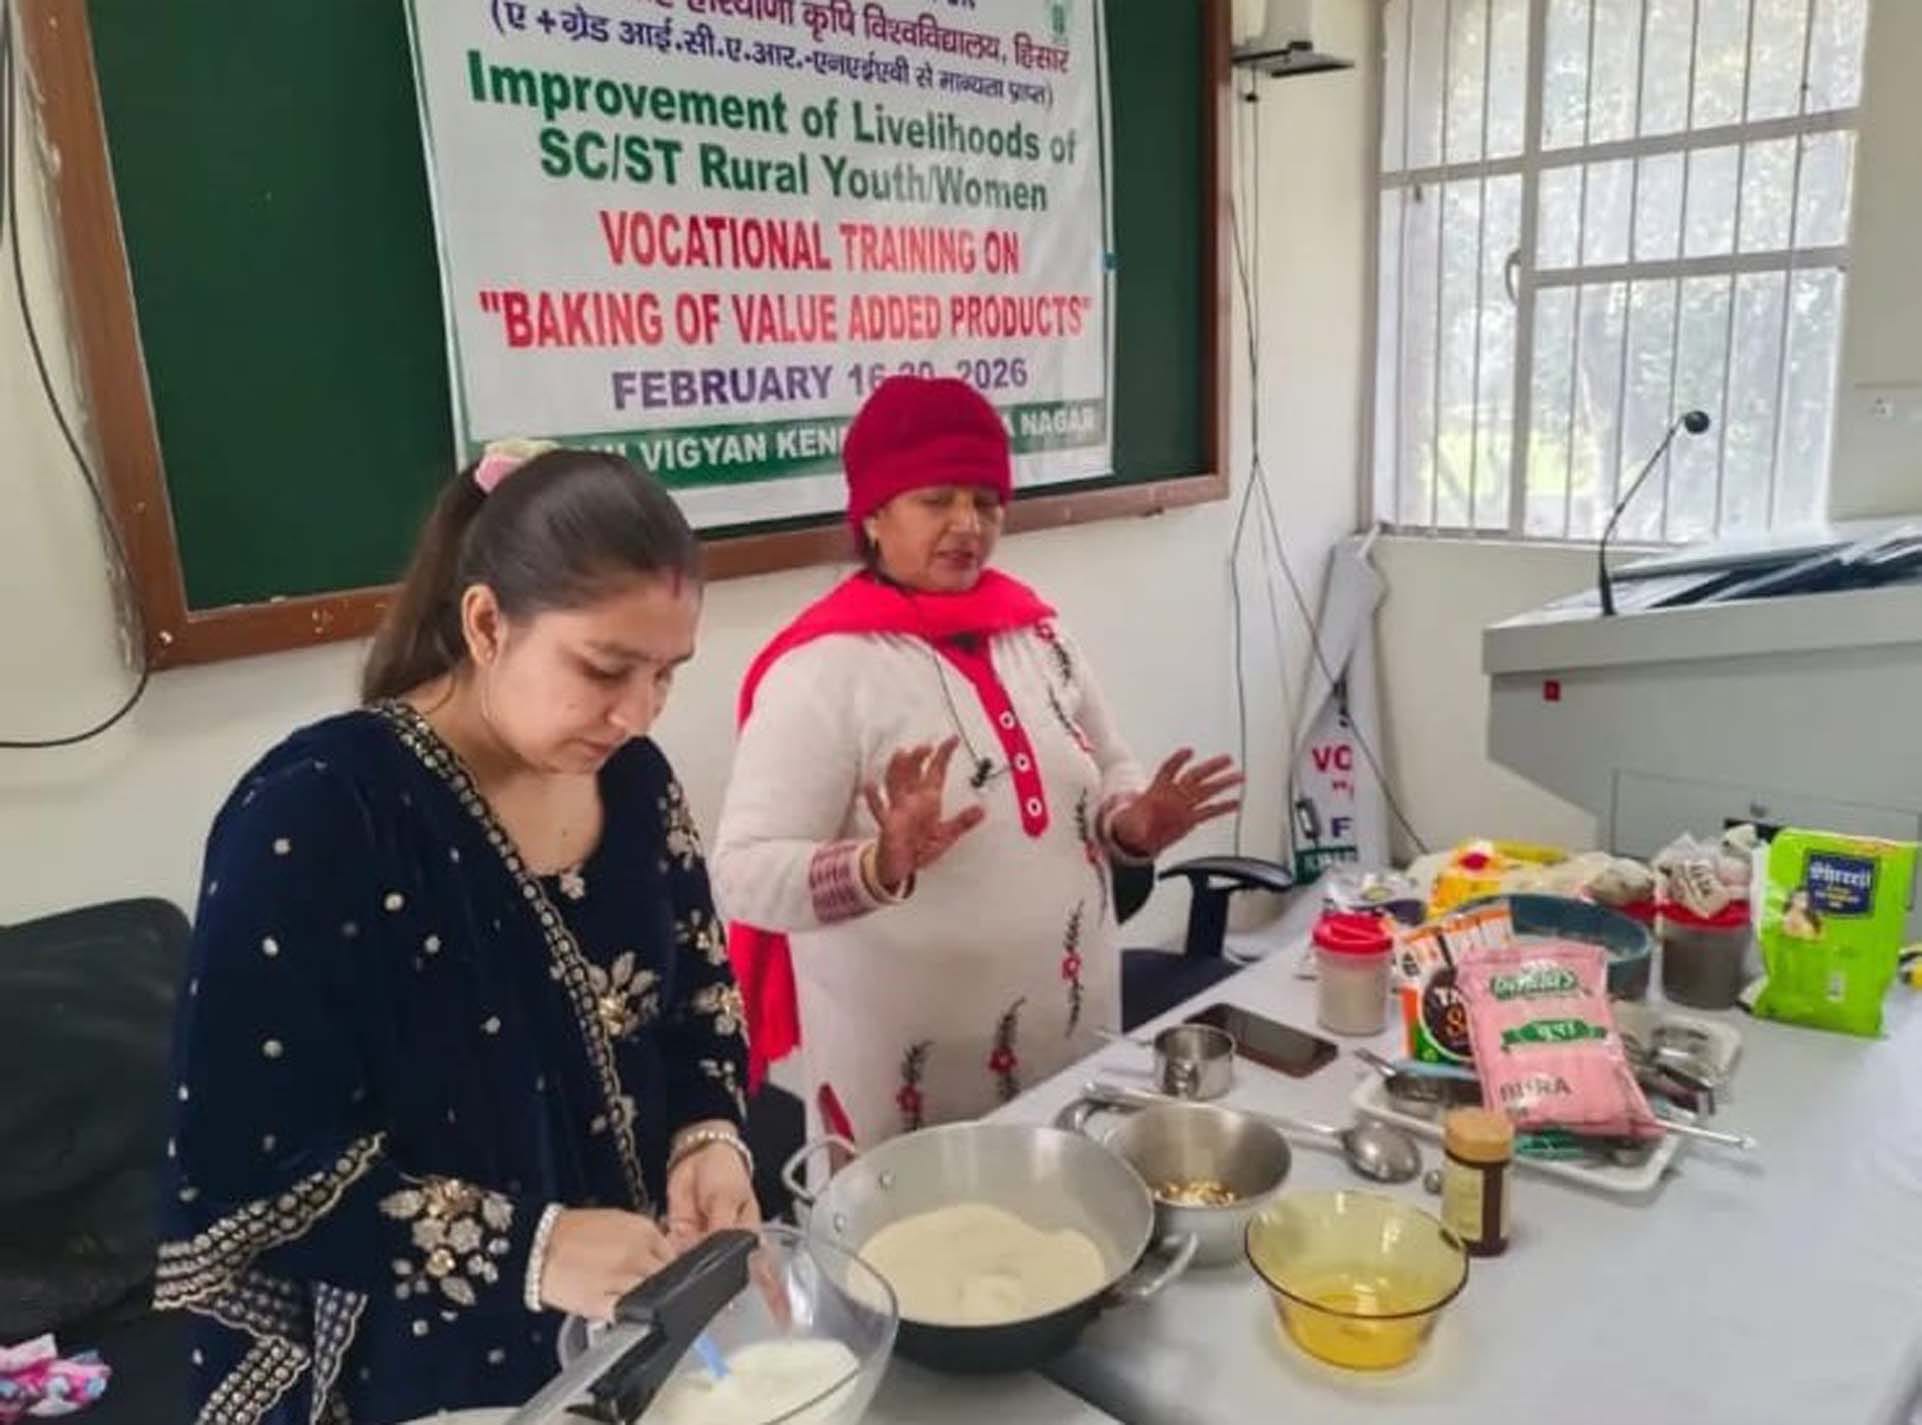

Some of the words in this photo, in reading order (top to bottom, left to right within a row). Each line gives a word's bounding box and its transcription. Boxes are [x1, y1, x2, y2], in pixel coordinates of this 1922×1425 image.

[915, 61, 933, 89] से
[938, 68, 1004, 98] मान्यता
[1014, 32, 1069, 73] हिसार
[467, 50, 788, 137] Improvement
[803, 97, 839, 140] of
[853, 101, 1040, 161] Livelihoods
[1050, 129, 1077, 165] of
[539, 127, 683, 186] SC/ST
[698, 142, 809, 197] Rural
[820, 154, 1048, 211] Youth/Women
[600, 210, 832, 271] VOCATIONAL
[840, 223, 976, 274] TRAINING
[984, 231, 1020, 274] ON
[479, 290, 663, 348] "BAKING
[675, 292, 721, 346] OF
[731, 293, 839, 344] VALUE
[848, 294, 942, 342] ADDED
[951, 296, 1093, 340] PRODUCTS"
[611, 365, 833, 411] FEBRUARY
[957, 357, 1028, 390] 2026
[640, 431, 768, 472] VIGYAN
[1020, 407, 1095, 437] NAGAR
